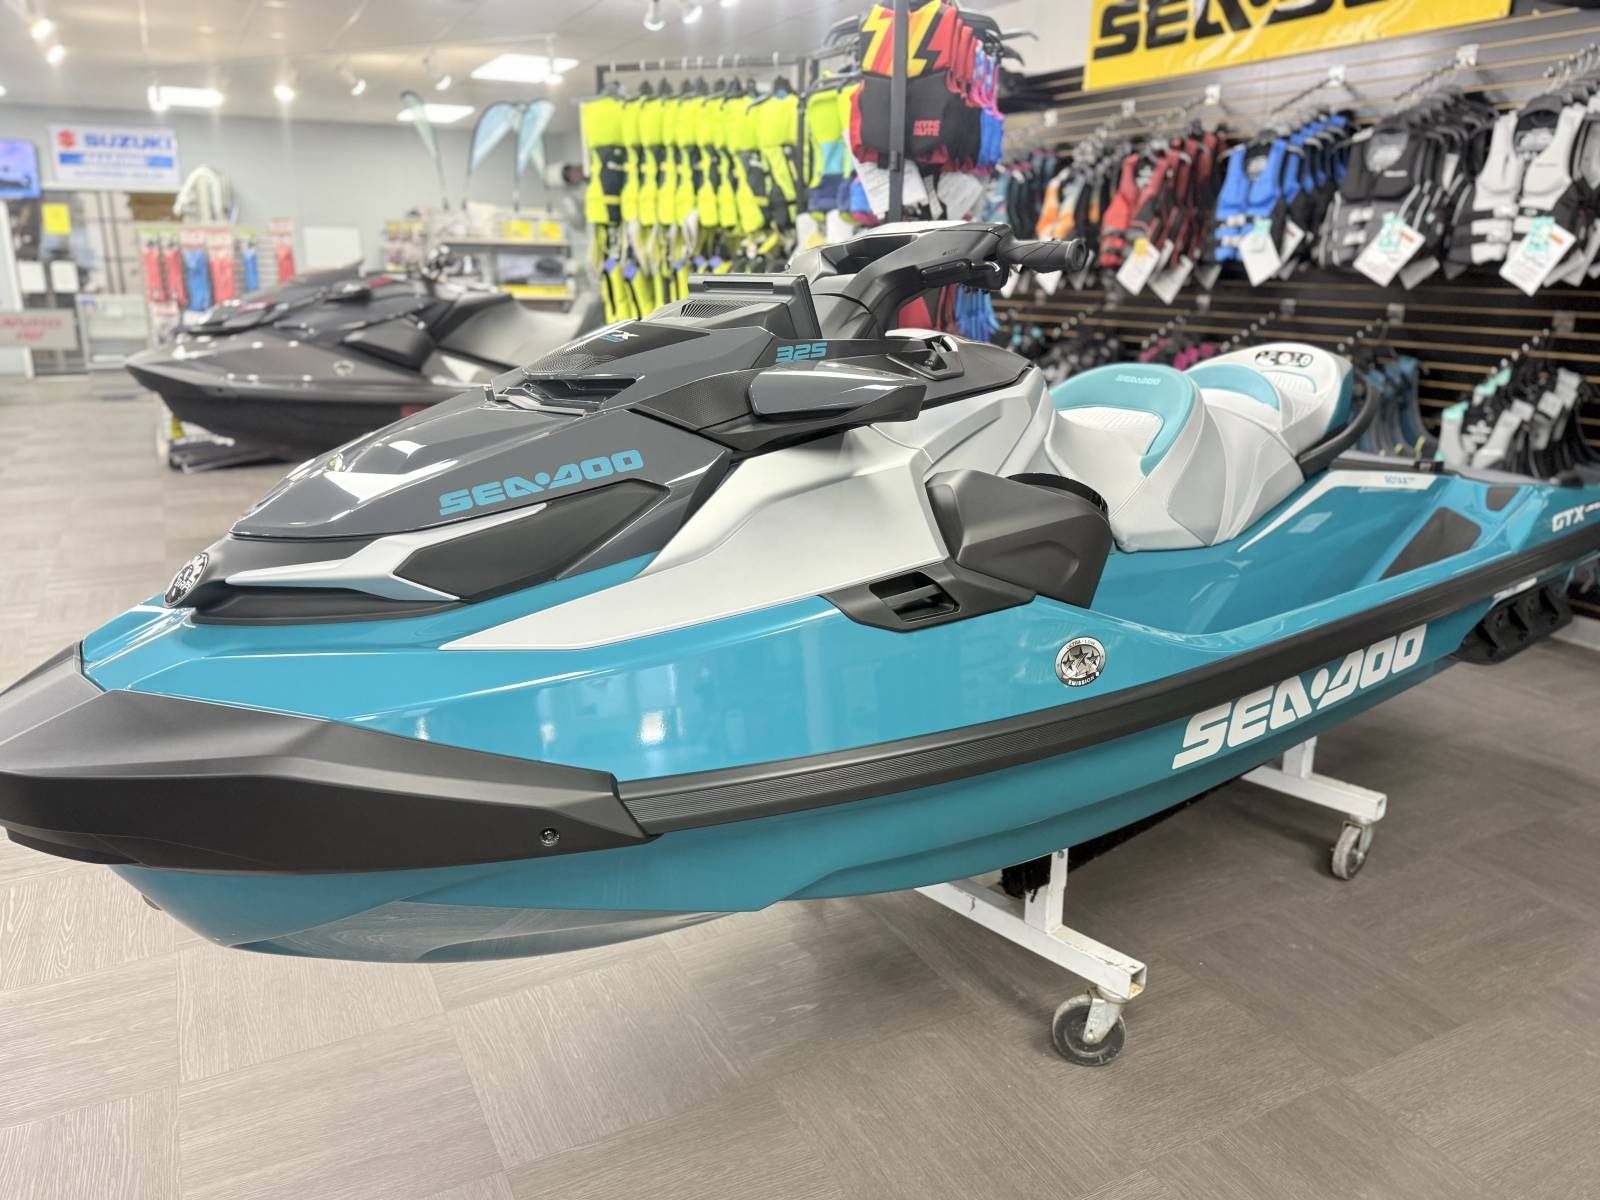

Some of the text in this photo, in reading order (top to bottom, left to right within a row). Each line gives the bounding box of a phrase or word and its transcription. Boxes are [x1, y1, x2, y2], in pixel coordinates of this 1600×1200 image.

[84, 132, 172, 150] SUZUKI
[776, 342, 828, 366] 325
[1552, 505, 1585, 533] GTX
